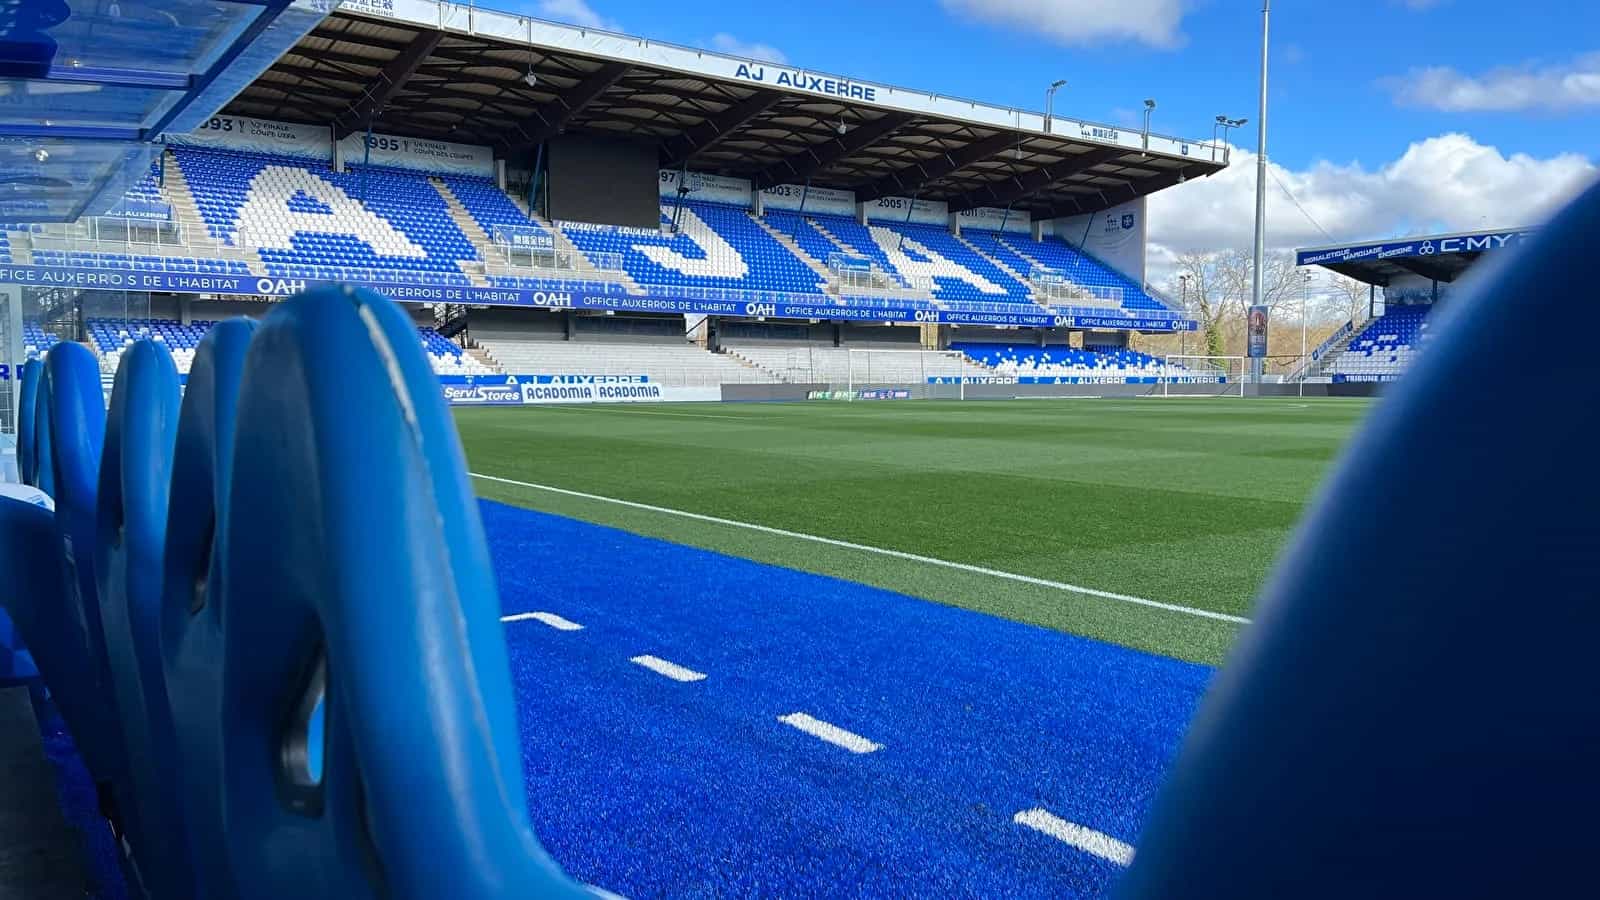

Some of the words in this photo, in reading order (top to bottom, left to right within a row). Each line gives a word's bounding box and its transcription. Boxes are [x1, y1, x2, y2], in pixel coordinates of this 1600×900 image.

[735, 64, 764, 81] AJ
[777, 71, 876, 101] AUXERRE
[251, 129, 276, 137] COUPE
[878, 198, 903, 209] 2005
[558, 220, 602, 232] LOUAULT
[617, 225, 658, 237] LOUAULT
[143, 275, 162, 287] DE
[168, 278, 241, 291] L'HABITAT
[256, 279, 306, 295] OAH
[373, 286, 442, 299] AUXERROIS
[446, 290, 463, 300] DE
[467, 290, 522, 303] L'HABITAT
[533, 291, 572, 307] OAH
[583, 296, 619, 307] OFFICE
[621, 299, 677, 310] AUXERROIS
[678, 302, 692, 311] DE
[694, 303, 737, 314] L'HABITAT
[745, 303, 776, 316] OAH
[784, 306, 813, 316] OFFICE
[814, 308, 859, 319] AUXERROIS
[860, 310, 872, 320] DE
[873, 310, 907, 320] L'HABITAT
[915, 311, 939, 322] OAH
[946, 313, 970, 321] OFFICE
[971, 314, 1008, 323] AUXERROIS
[1019, 315, 1048, 325] L'HABITAT
[1054, 316, 1075, 327] OAH
[1081, 318, 1100, 326] OFFICE
[1101, 319, 1132, 328] AUXERROIS
[1133, 320, 1141, 328] DE
[1172, 319, 1190, 330] OAH
[1345, 375, 1379, 383] TRIBUNE
[526, 387, 592, 400] ACADOMIA
[599, 385, 660, 398] ACADOMIA
